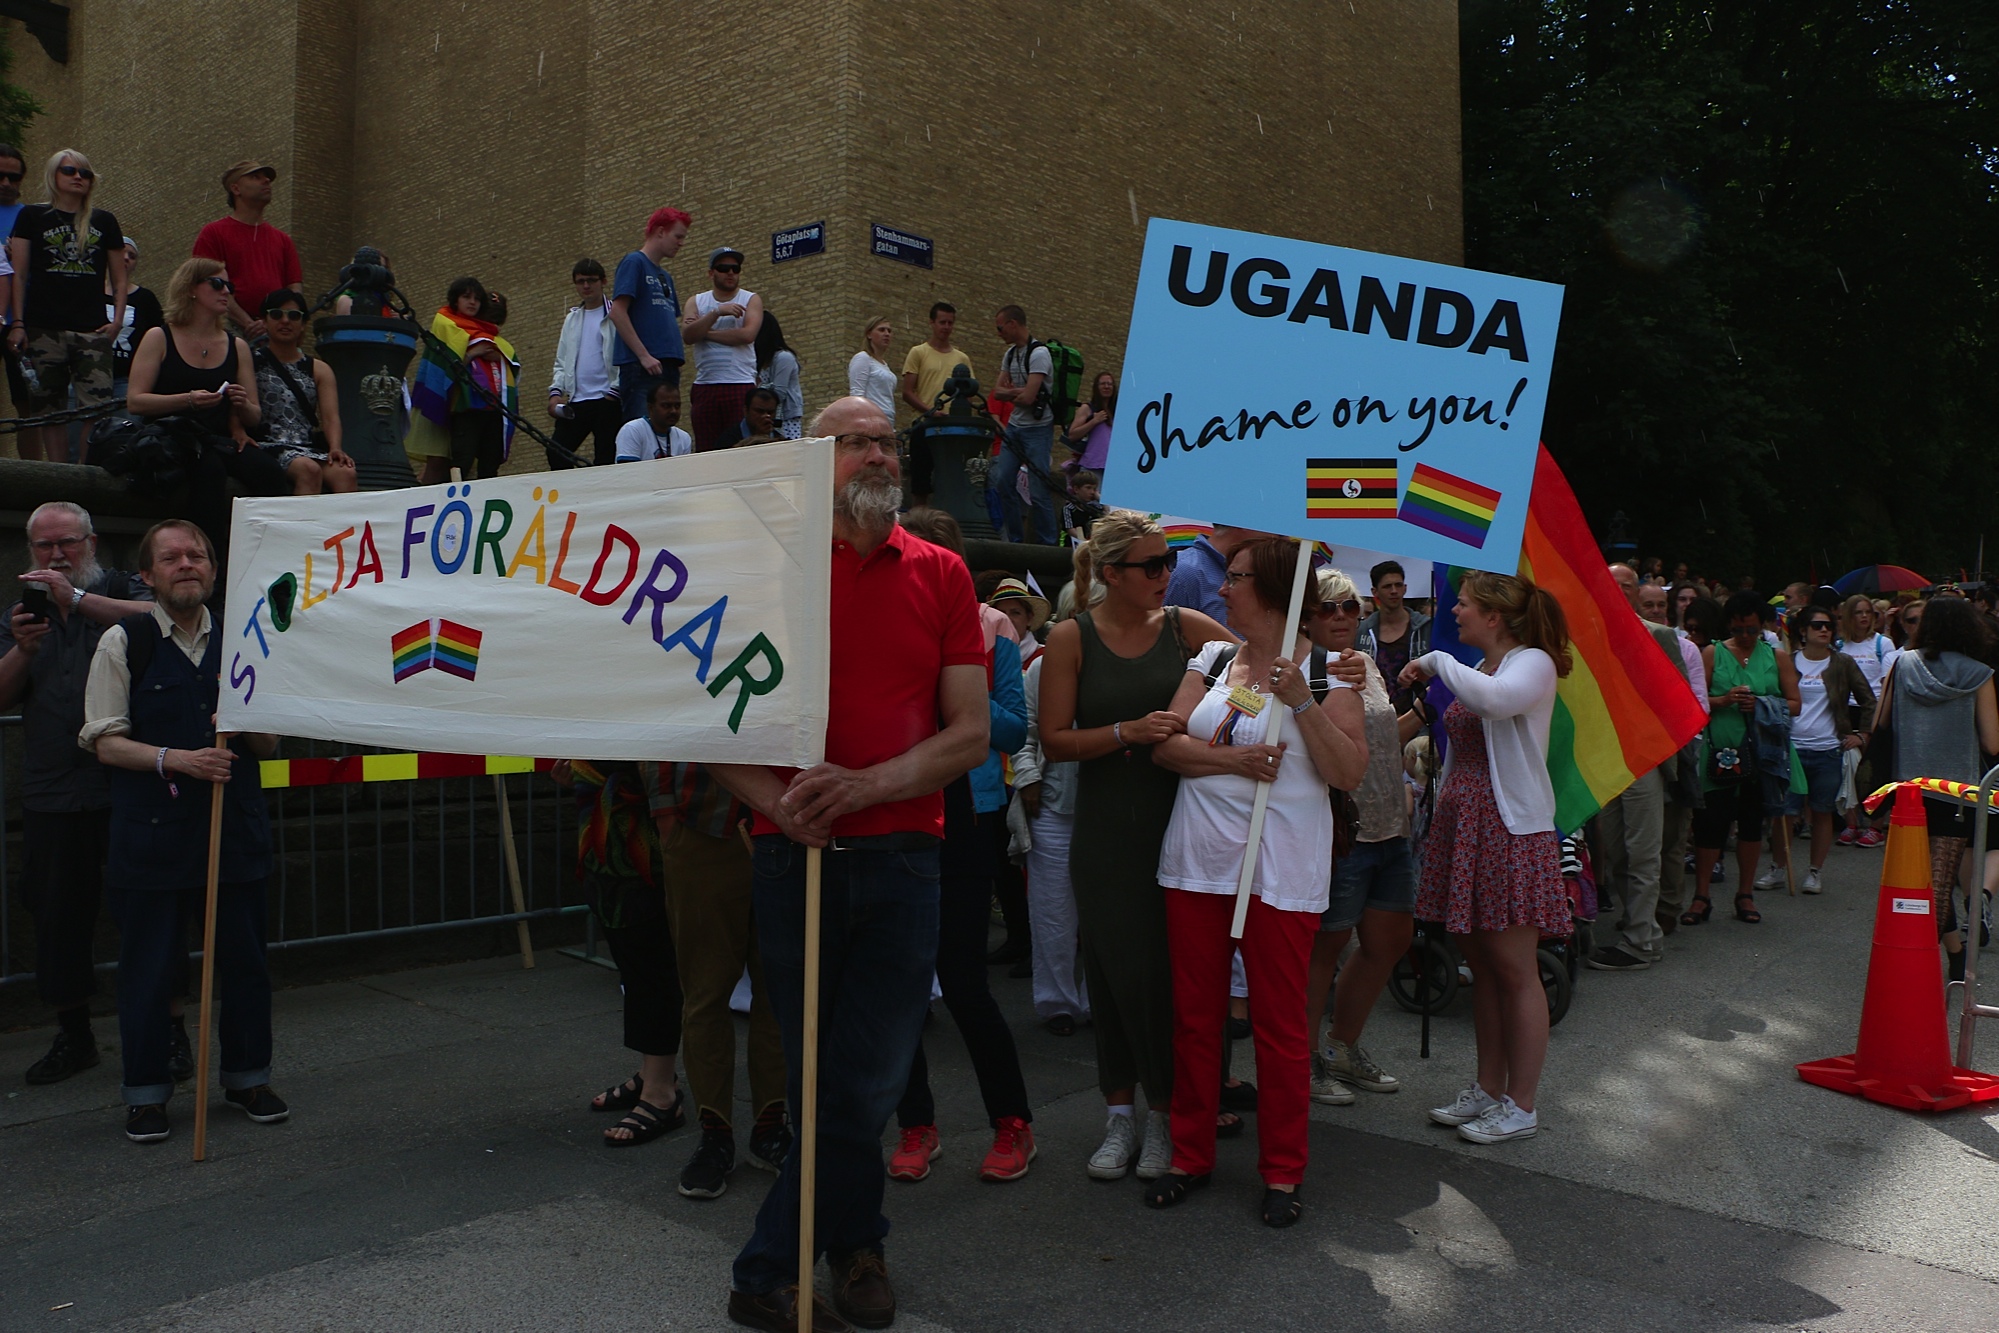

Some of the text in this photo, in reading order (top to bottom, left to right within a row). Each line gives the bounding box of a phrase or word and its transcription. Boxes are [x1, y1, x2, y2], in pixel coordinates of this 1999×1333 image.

[875, 226, 930, 251] Stenhammars-
[875, 241, 899, 255] gatan
[1168, 245, 1529, 363] UGANDA
[1136, 377, 1528, 474] Shame on you!
[230, 484, 784, 734] STOLTA FÖRÄLDRAR
